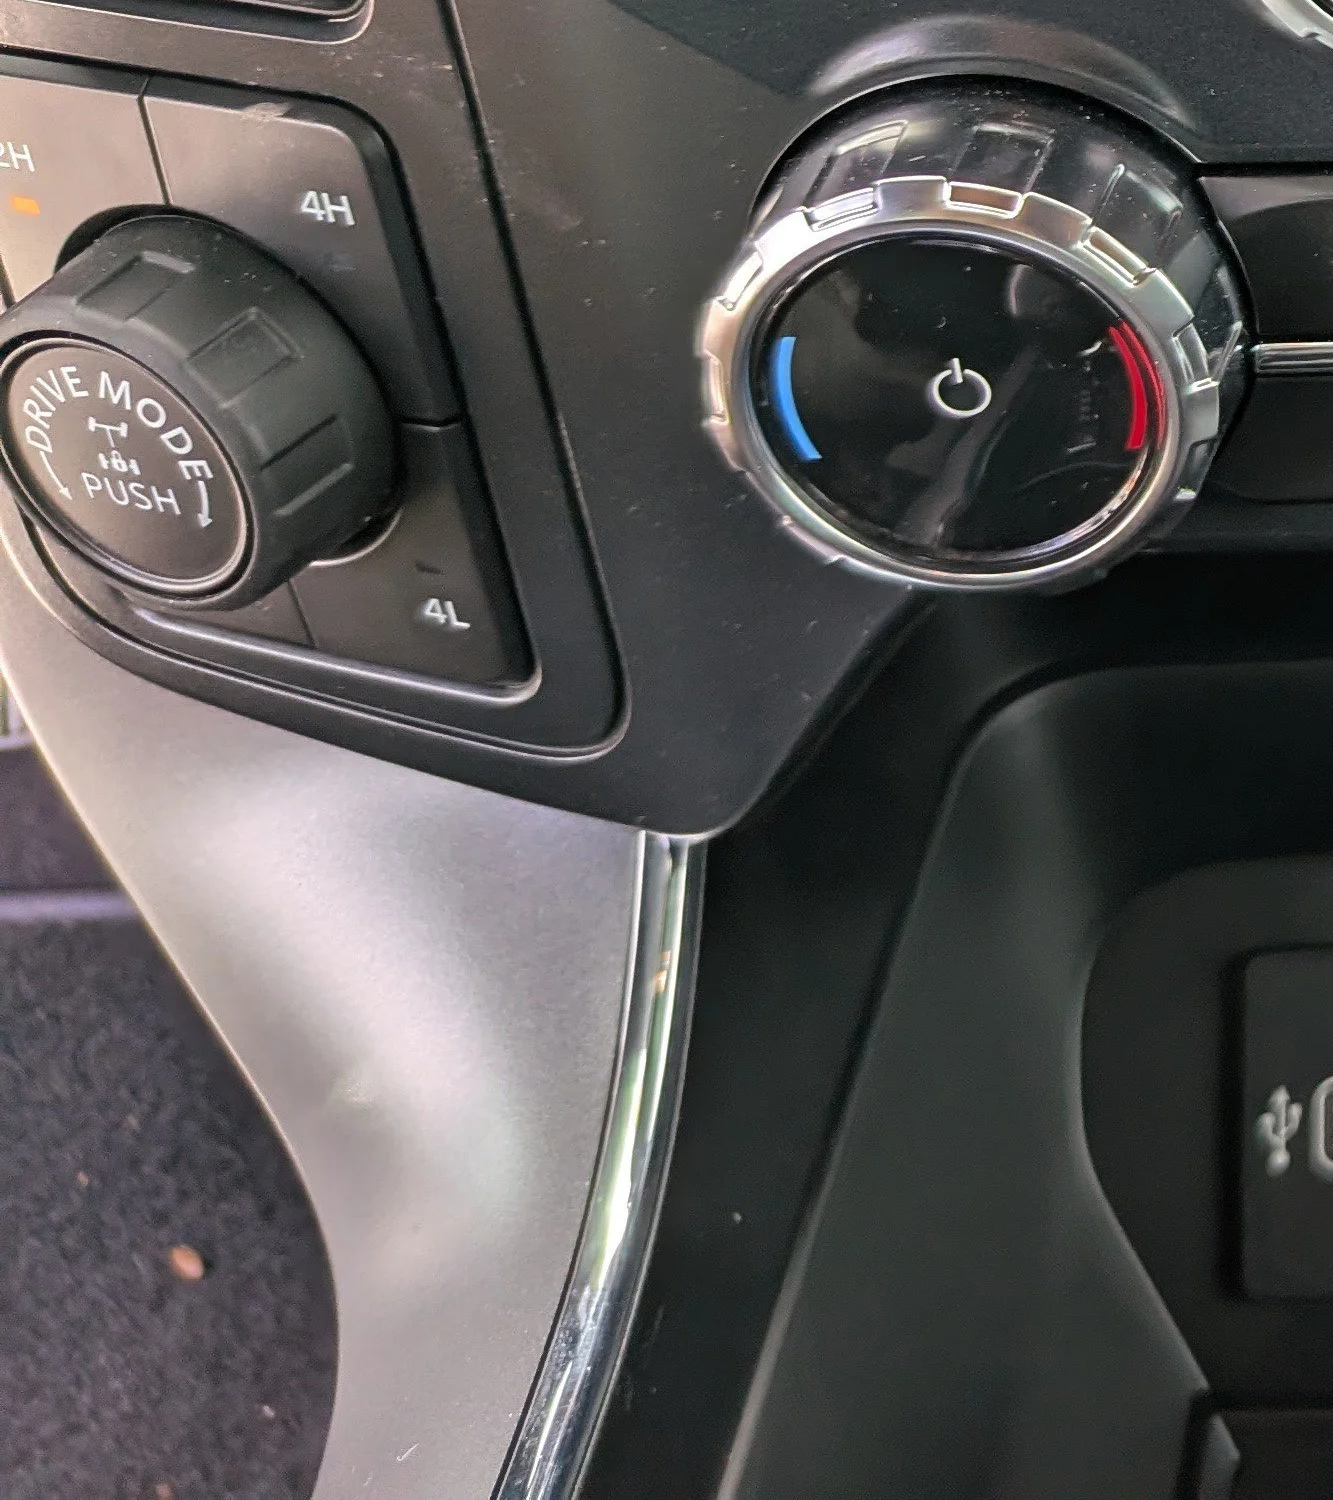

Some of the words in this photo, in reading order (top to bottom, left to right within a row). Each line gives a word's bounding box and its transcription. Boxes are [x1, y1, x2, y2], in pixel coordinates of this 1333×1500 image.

[300, 190, 355, 226] 4H
[23, 365, 90, 454] DRIVE
[98, 370, 214, 481] MODE
[80, 471, 181, 516] PUSH
[422, 597, 472, 630] 4L
